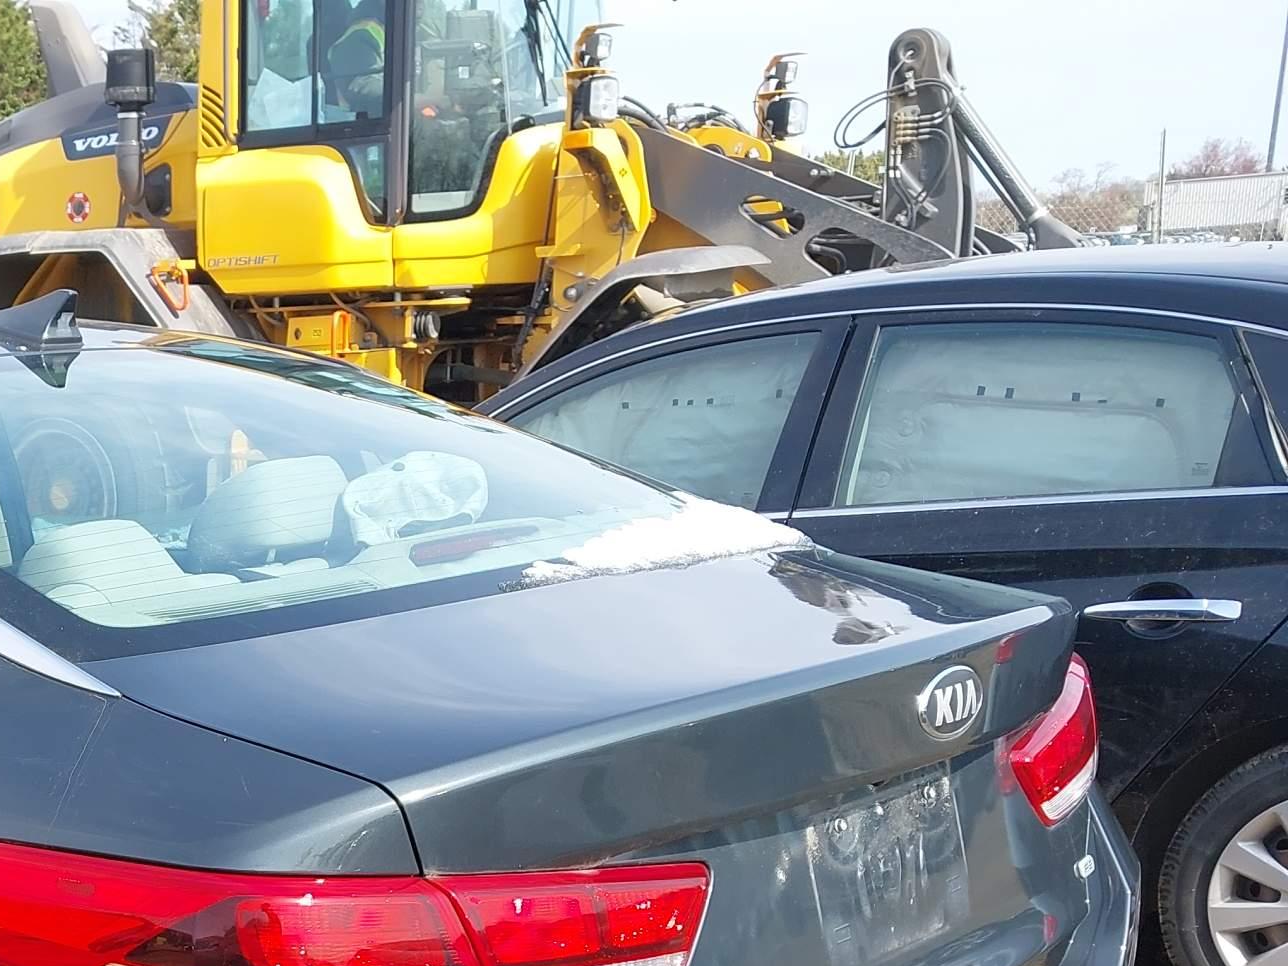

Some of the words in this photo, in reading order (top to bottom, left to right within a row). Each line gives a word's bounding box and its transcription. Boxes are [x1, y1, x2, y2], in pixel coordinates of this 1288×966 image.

[72, 126, 160, 152] VOLO
[208, 254, 280, 268] OPTISHIFT
[933, 678, 978, 727] KIA
